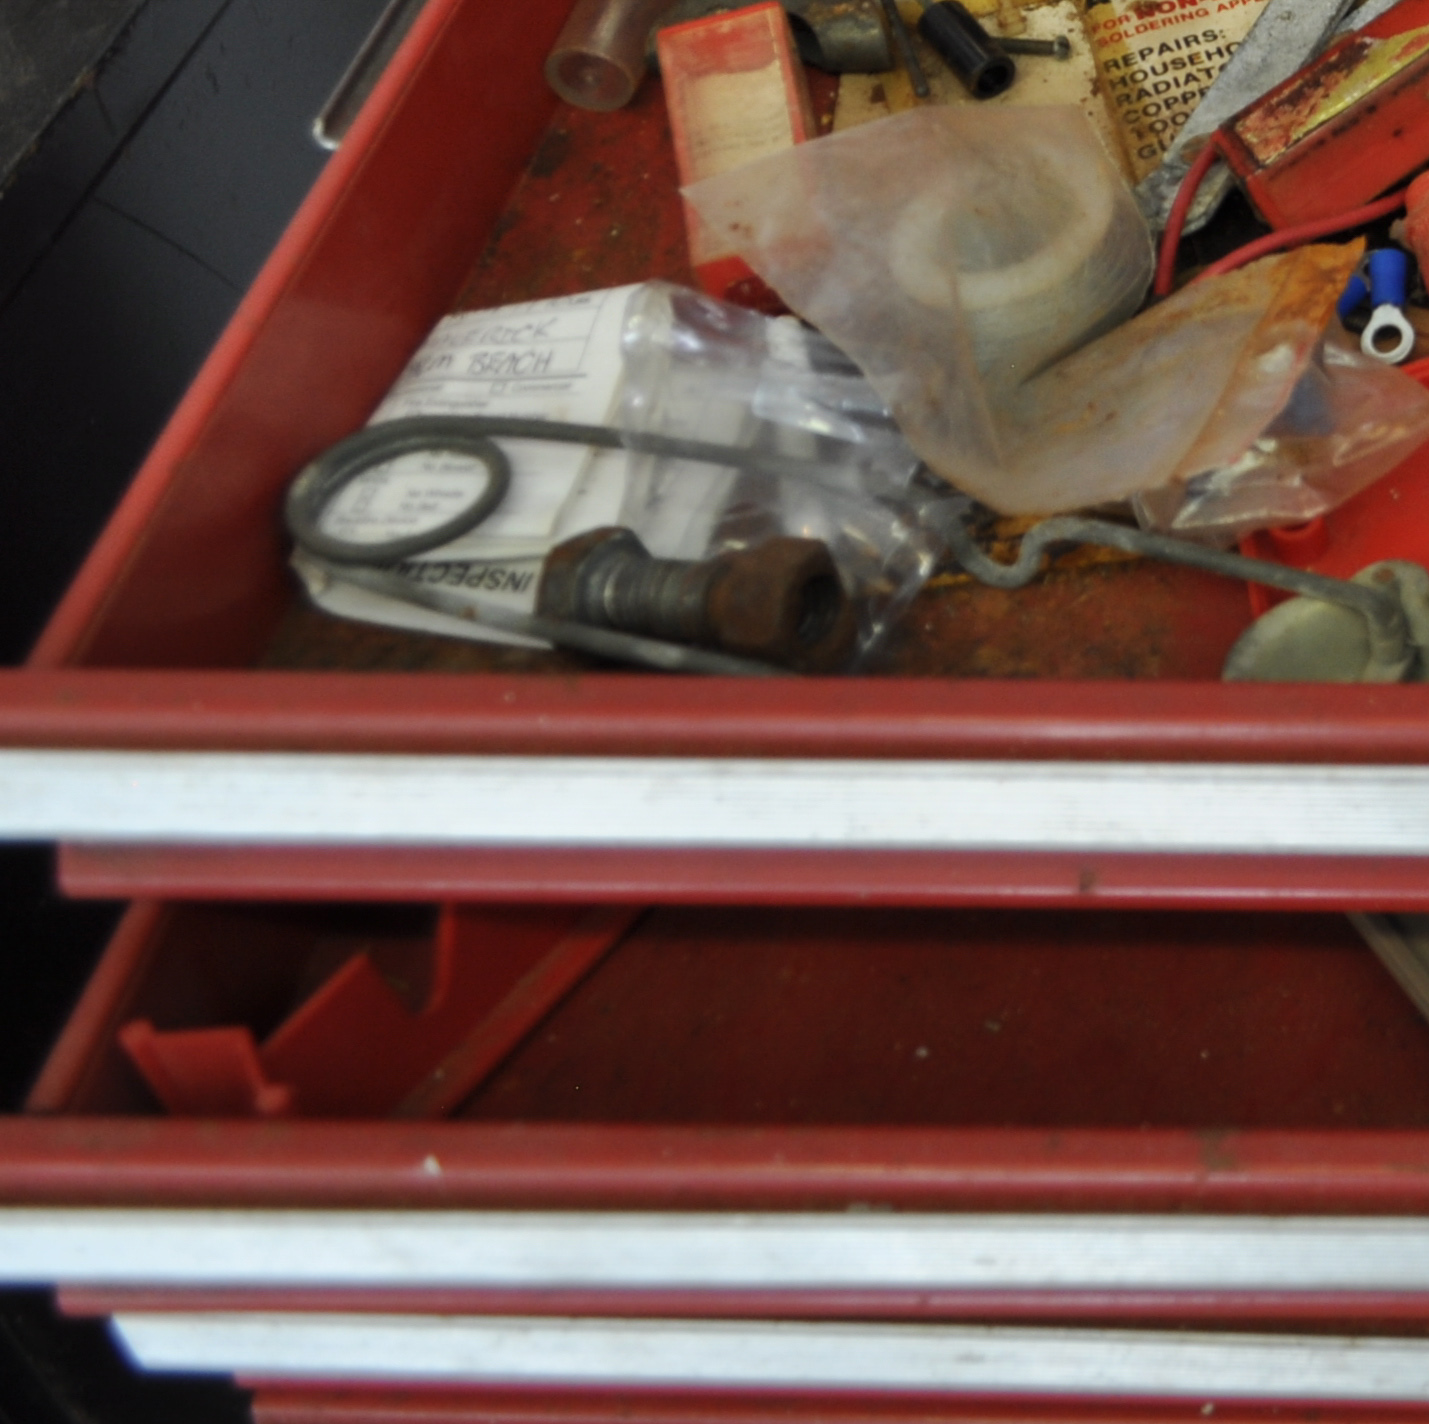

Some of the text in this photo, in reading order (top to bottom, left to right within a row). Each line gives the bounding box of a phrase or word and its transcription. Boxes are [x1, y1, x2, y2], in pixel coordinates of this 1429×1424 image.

[1091, 13, 1131, 37] FOR
[1097, 8, 1210, 48] SOLDERING
[1102, 29, 1227, 74] REPAIRS:
[1115, 63, 1228, 108] RADIAT
